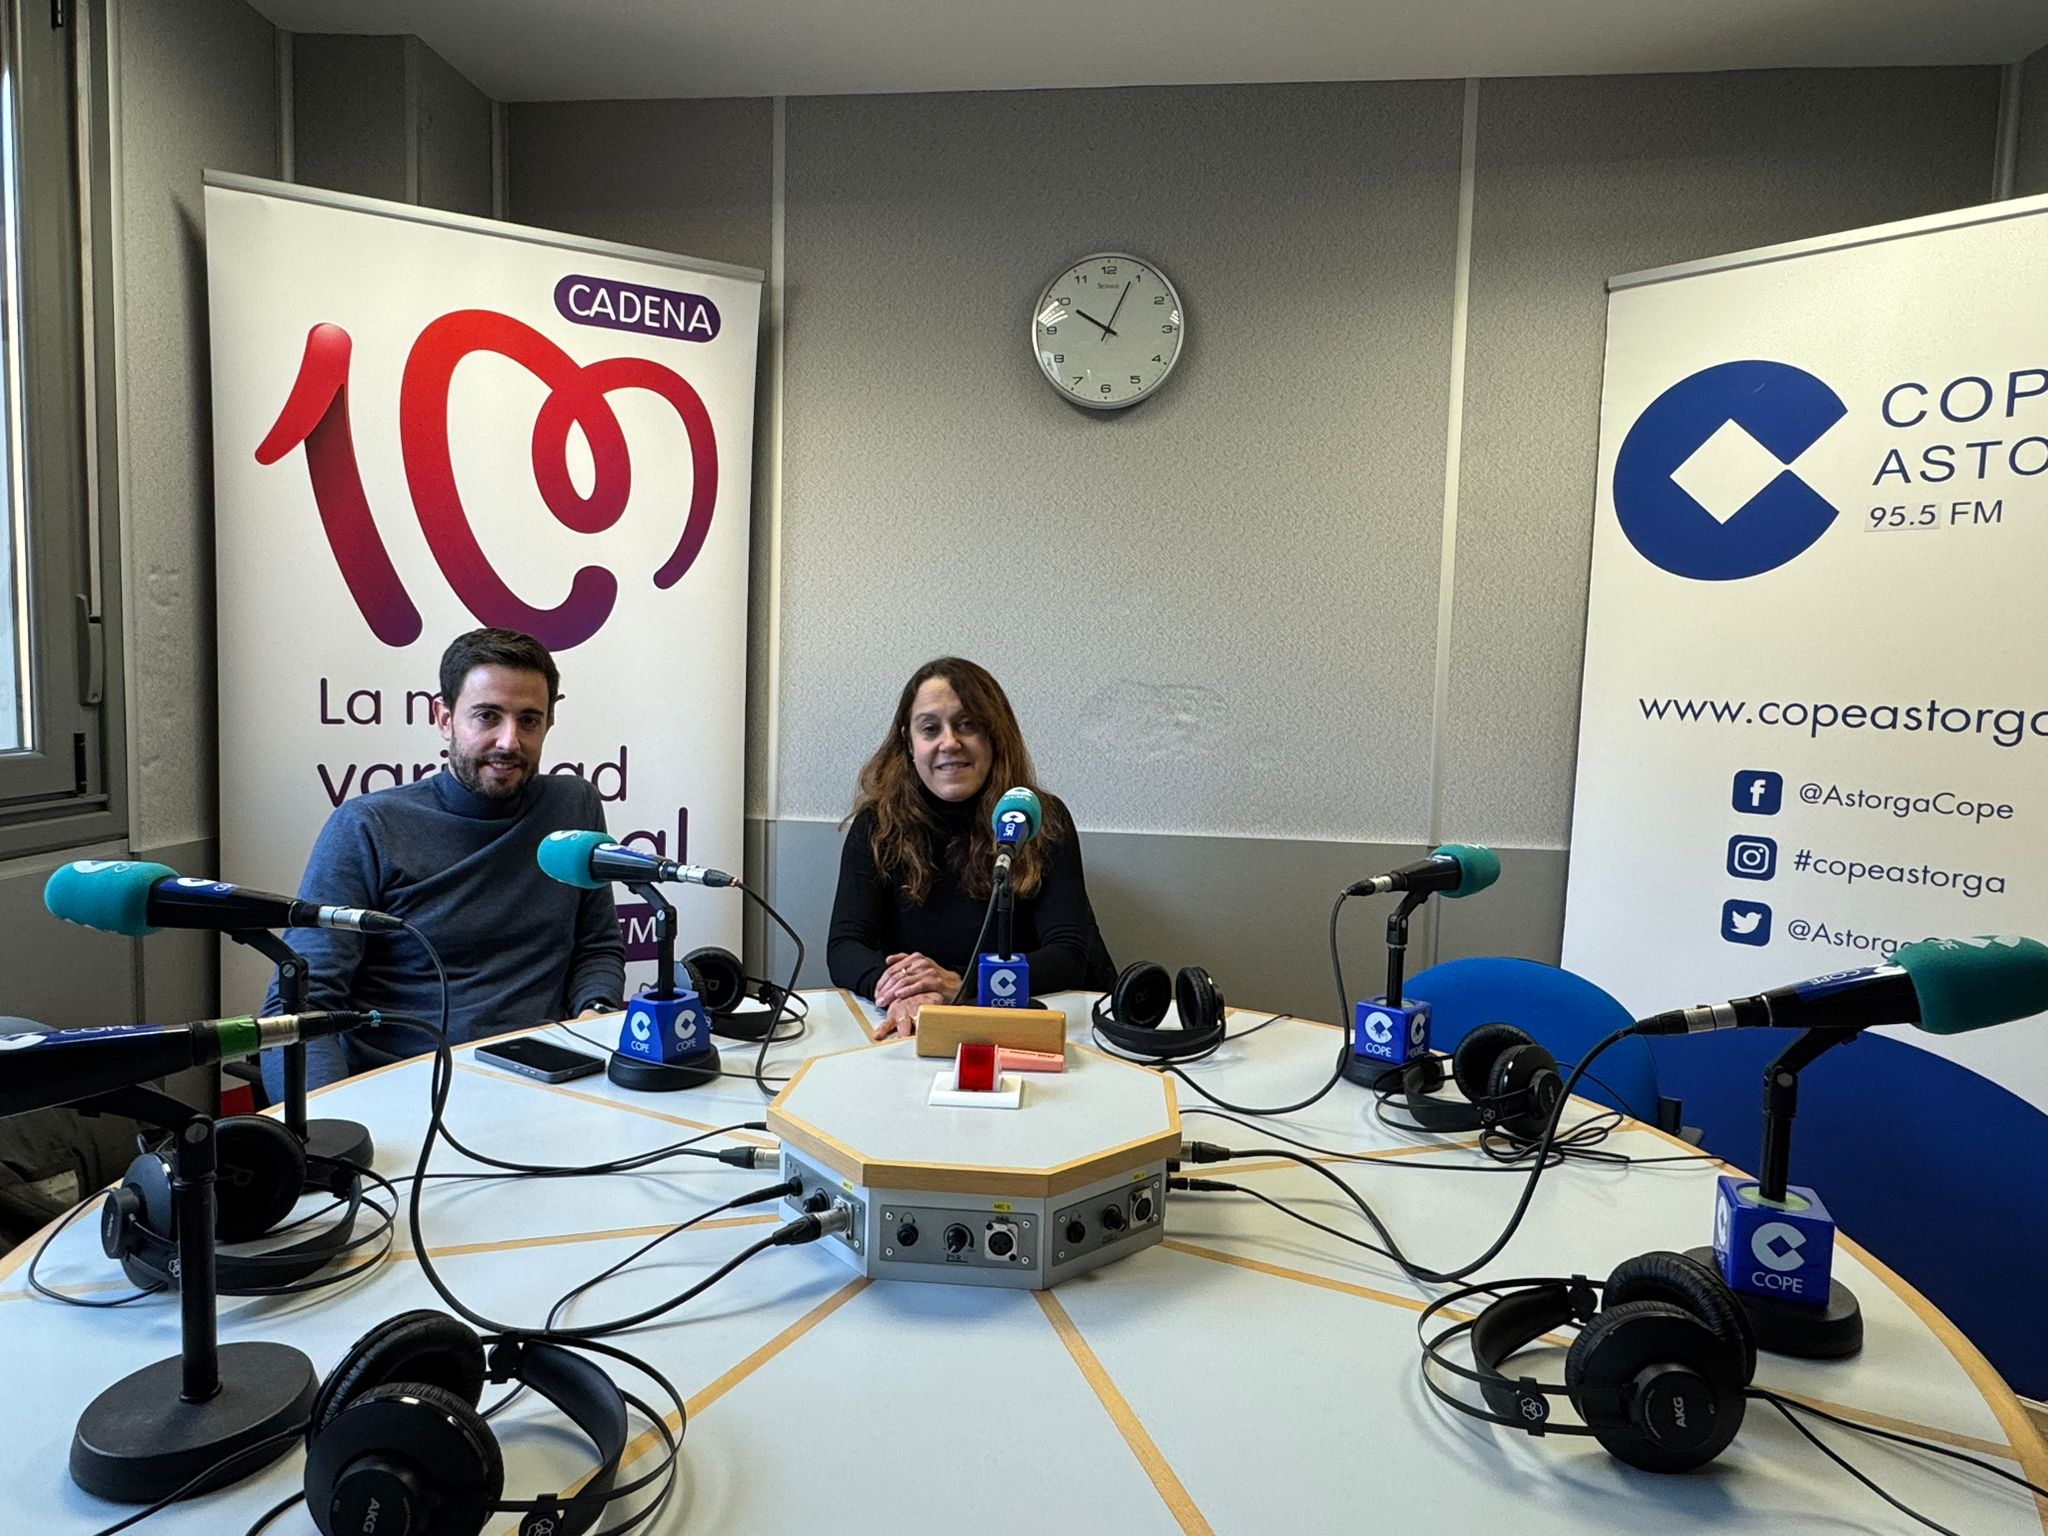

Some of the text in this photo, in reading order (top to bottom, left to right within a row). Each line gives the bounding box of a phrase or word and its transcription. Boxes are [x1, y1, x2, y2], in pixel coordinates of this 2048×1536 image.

[1101, 266, 1117, 275] 12
[1074, 275, 1087, 284] 11
[1135, 274, 1141, 283] 1
[1153, 296, 1165, 305] 2
[568, 284, 713, 336] CADENA
[1046, 326, 1057, 335] 9
[1162, 325, 1173, 334] 3
[1054, 354, 1065, 363] 8
[1151, 354, 1161, 363] 4
[1072, 376, 1084, 385] 7
[1130, 375, 1141, 384] 5
[1100, 384, 1112, 393] 6
[1881, 368, 2048, 429] COP
[1872, 436, 2048, 486] ASTO
[1870, 499, 2003, 528] 95.5 FM
[320, 677, 381, 725] La
[1799, 782, 2014, 824] @AstorgaCope
[1793, 849, 2005, 898] #copeastorga
[991, 998, 1016, 1007] COPE
[631, 1040, 650, 1053] COPE
[676, 1037, 696, 1052] COPE
[1366, 1042, 1392, 1058] COPE
[1751, 1271, 1804, 1293] COPE
[1673, 1396, 1688, 1429] AKG
[362, 1497, 380, 1534] AKG
